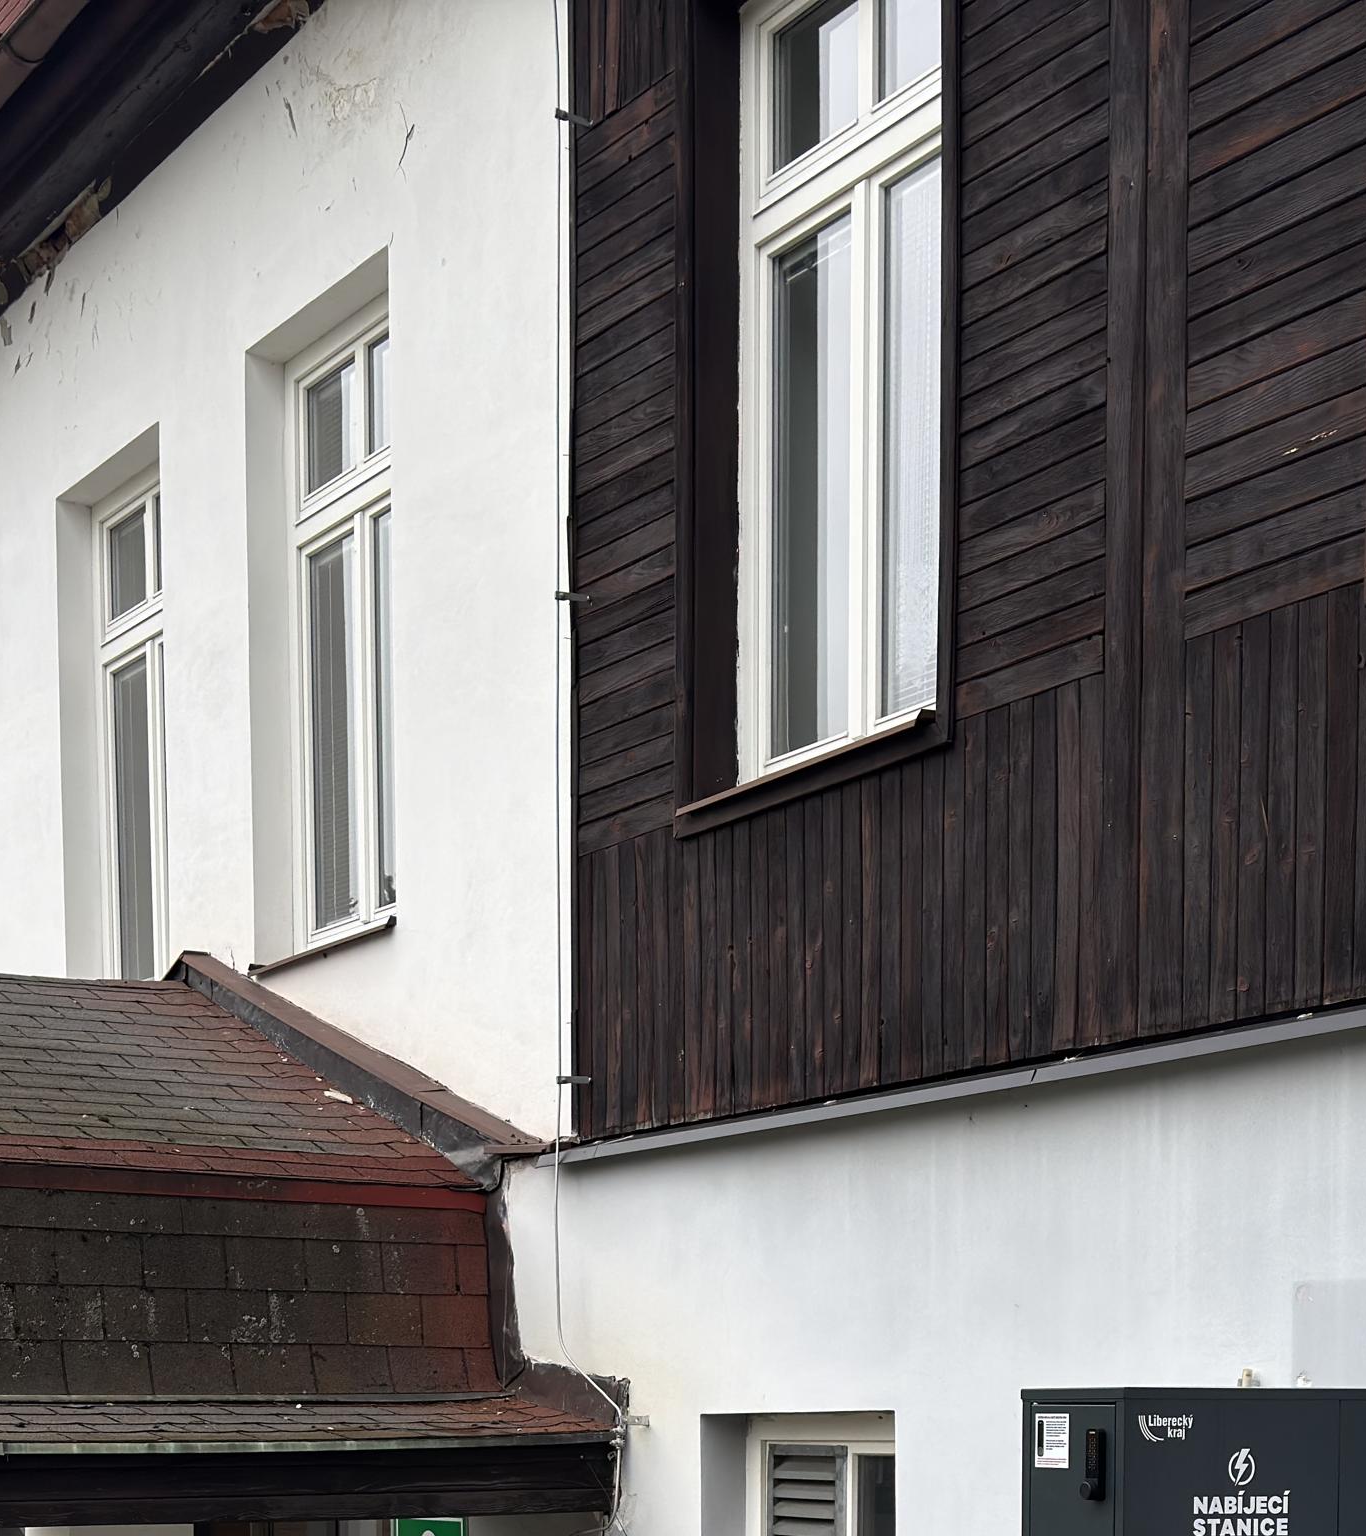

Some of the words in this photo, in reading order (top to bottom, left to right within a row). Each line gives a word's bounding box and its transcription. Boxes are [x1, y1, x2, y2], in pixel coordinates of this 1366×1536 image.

[1148, 1414, 1194, 1429] Liberecký
[1167, 1427, 1186, 1441] kraj
[1193, 1490, 1291, 1515] NABÍJECÍ
[1192, 1517, 1289, 1536] STANICE
